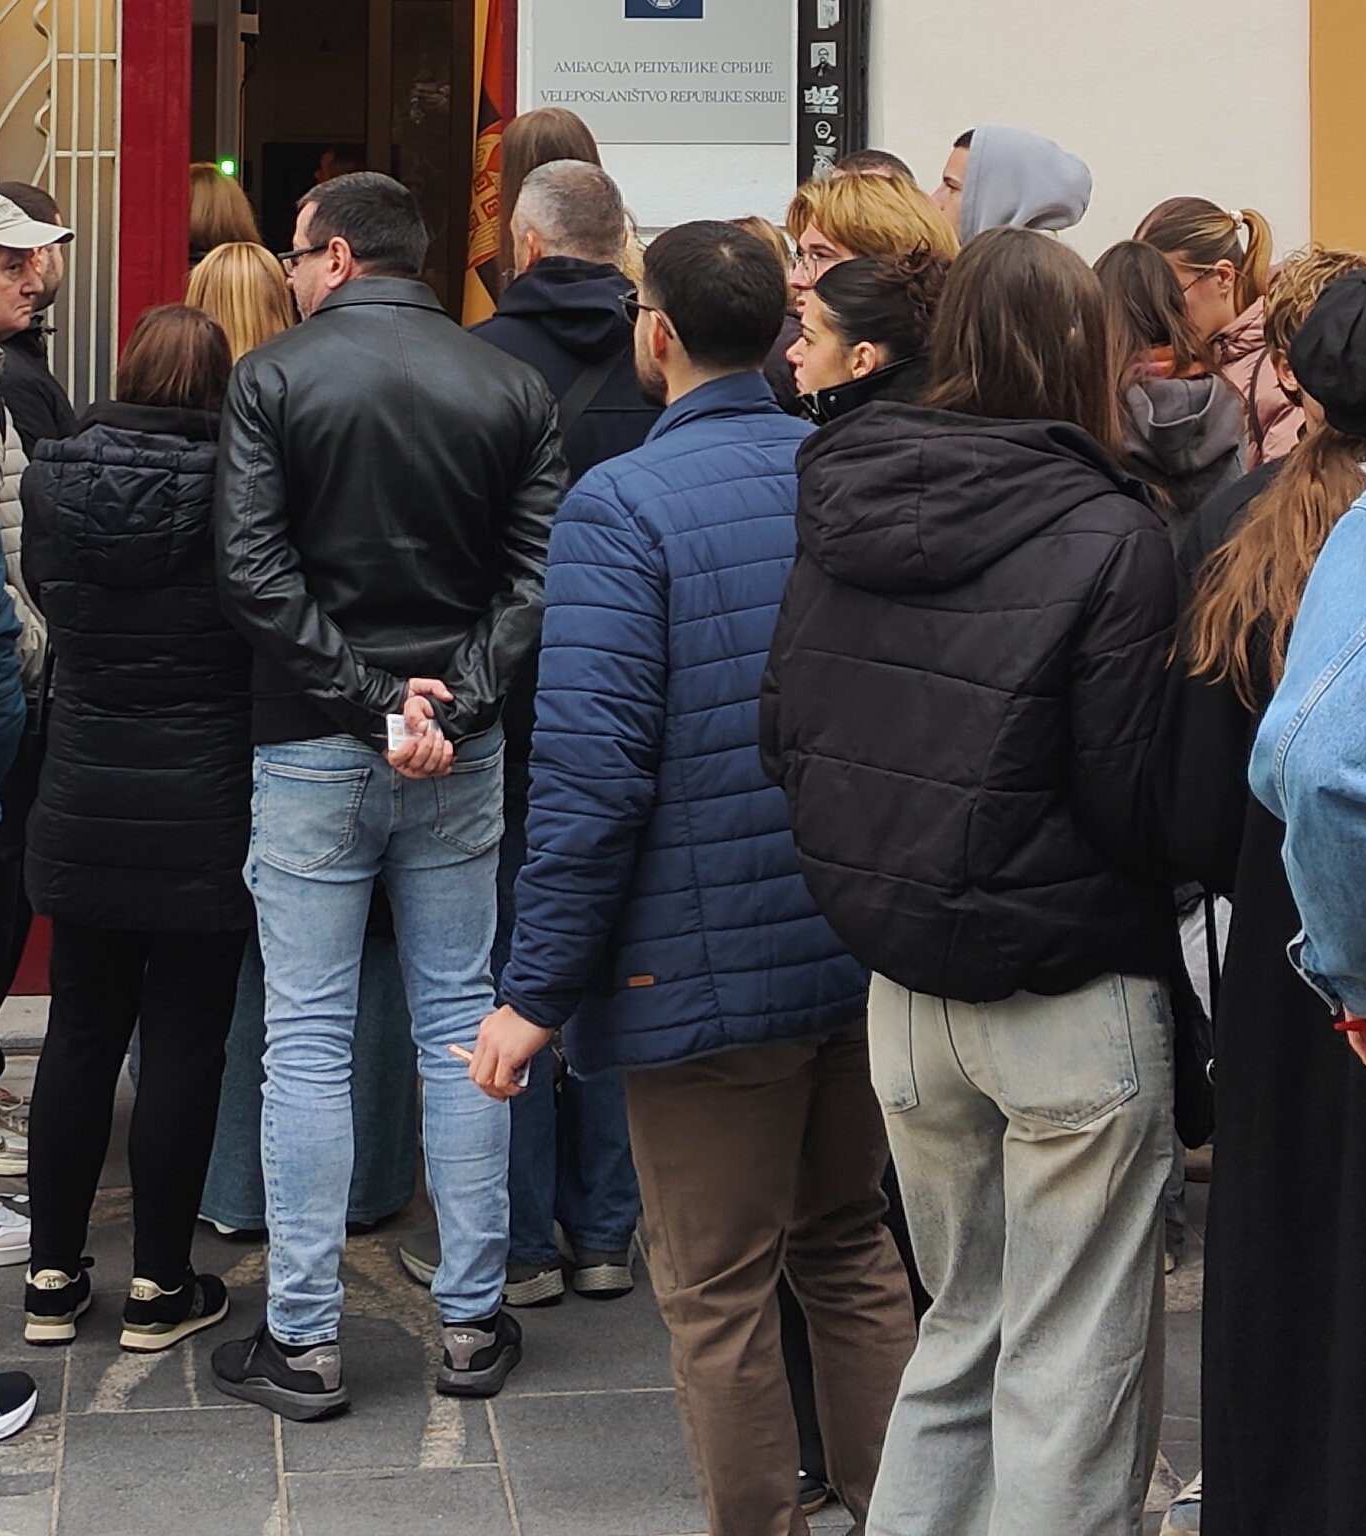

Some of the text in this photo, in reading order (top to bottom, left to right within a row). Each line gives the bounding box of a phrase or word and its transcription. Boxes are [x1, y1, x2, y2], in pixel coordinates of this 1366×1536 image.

[553, 61, 773, 74] АМБАСАДА РЕПУБЛИКЕ СРБИЈЕ
[540, 88, 787, 104] VELEPOSLANIŠTVO REPUBLIKE SRBIJE
